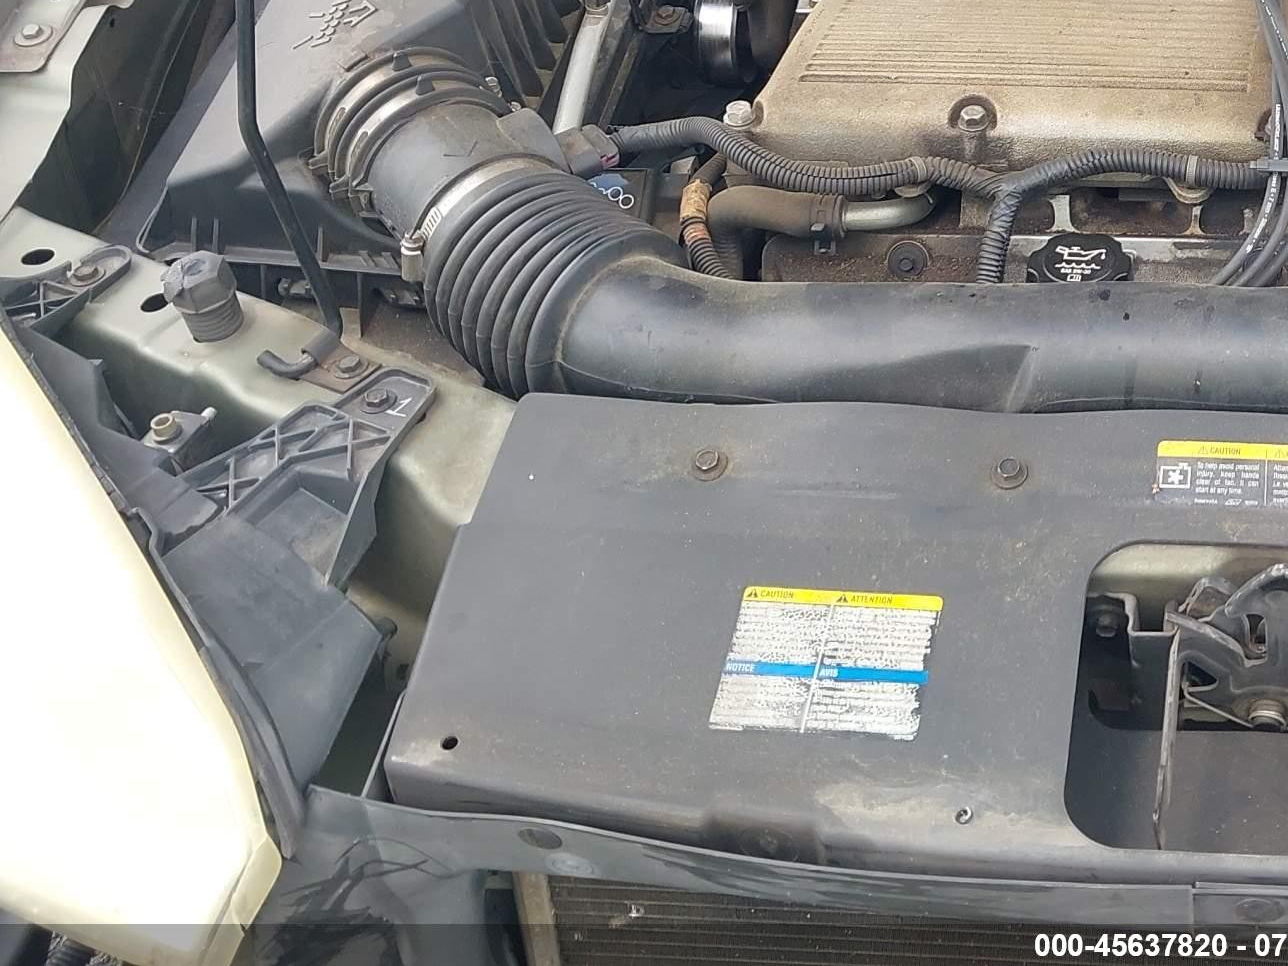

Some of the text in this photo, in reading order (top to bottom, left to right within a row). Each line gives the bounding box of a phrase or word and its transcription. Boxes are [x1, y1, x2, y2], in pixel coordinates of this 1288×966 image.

[1235, 464, 1260, 472] personal
[760, 590, 794, 599] CAUTION
[850, 595, 893, 604] ATTENTION
[726, 663, 755, 673] NOTICE
[819, 668, 839, 678] AVIS
